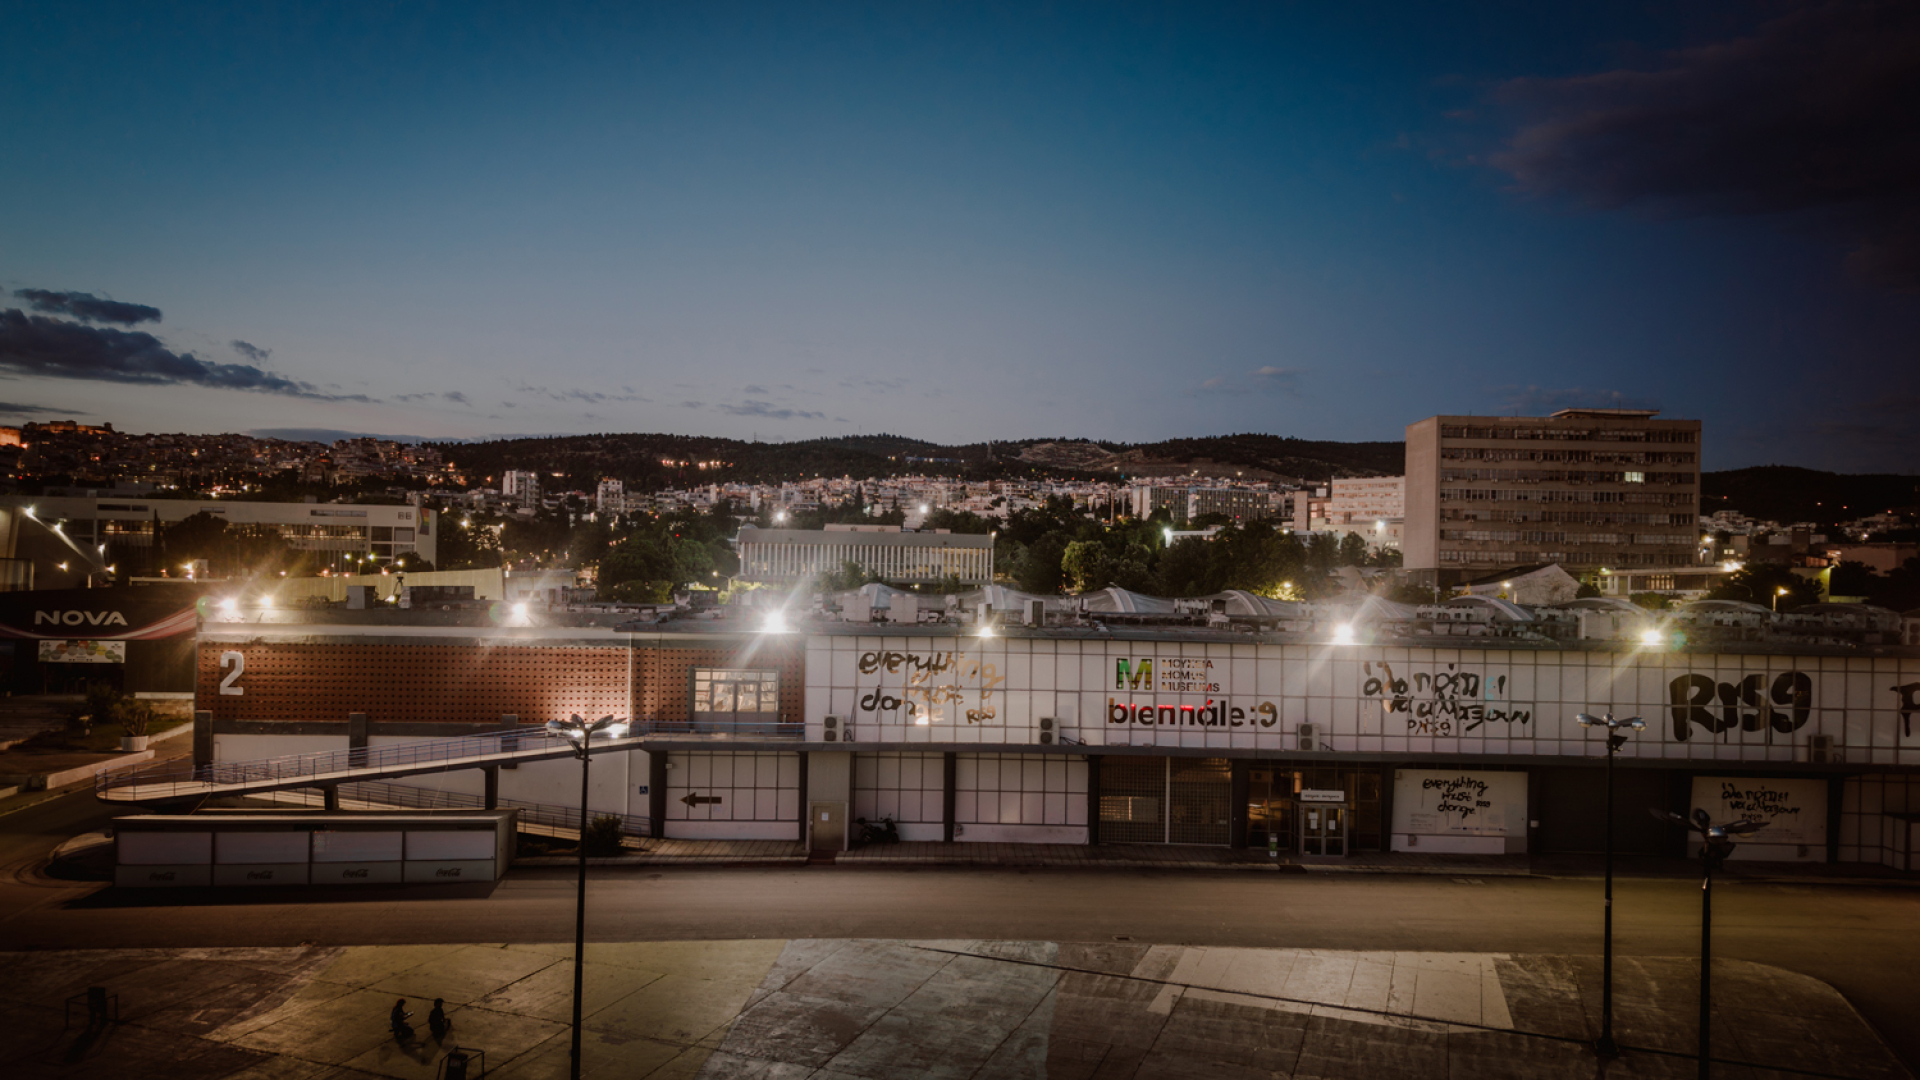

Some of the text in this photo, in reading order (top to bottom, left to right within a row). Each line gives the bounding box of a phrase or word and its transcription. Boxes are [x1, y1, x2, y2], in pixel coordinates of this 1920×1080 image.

[34, 610, 128, 626] NOVA
[219, 650, 244, 695] 2
[858, 652, 1005, 699] everything
[1116, 658, 1153, 691] M
[1162, 670, 1206, 681] MOMUS
[1162, 682, 1220, 692] MUSEUMS
[1422, 776, 1488, 796] everything
